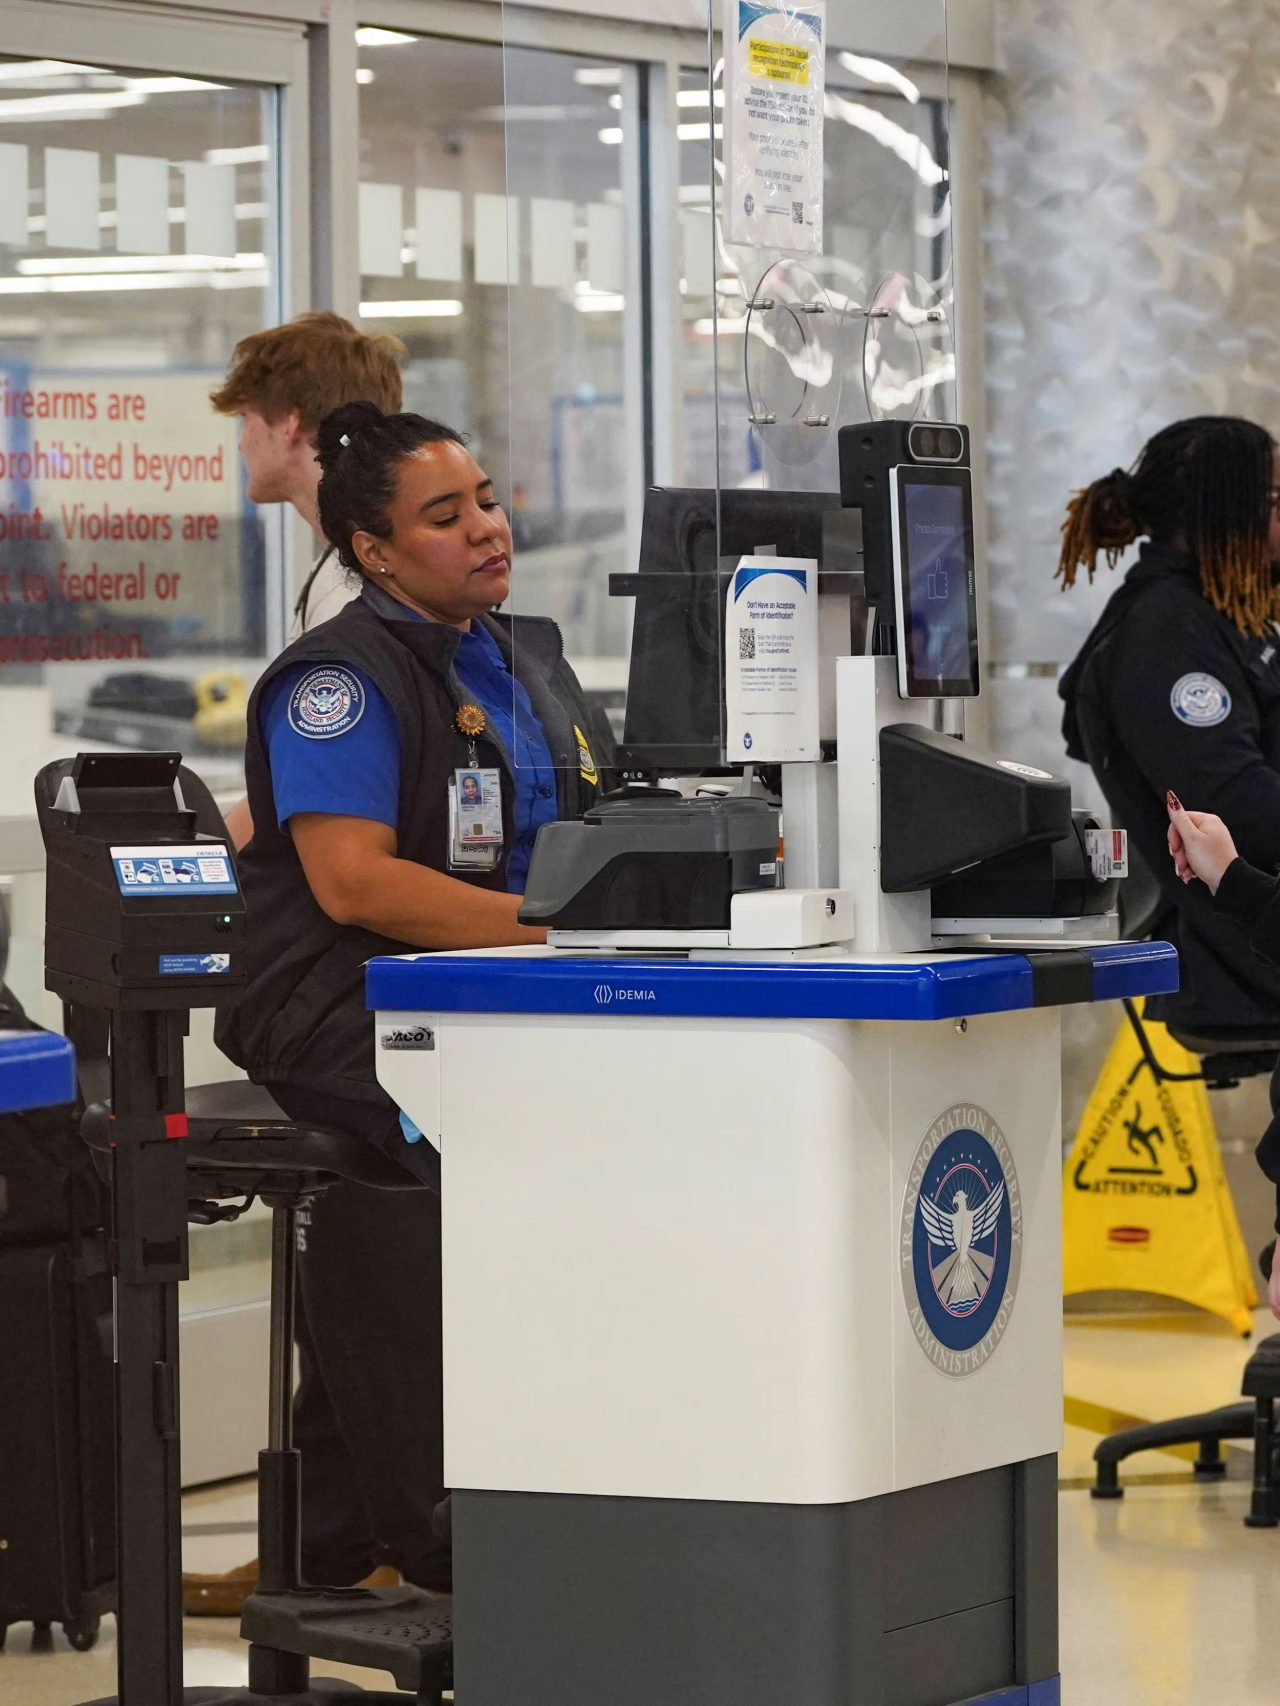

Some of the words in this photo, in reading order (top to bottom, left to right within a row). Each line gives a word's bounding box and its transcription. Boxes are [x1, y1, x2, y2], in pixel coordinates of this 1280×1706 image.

[108, 392, 146, 421] are
[133, 442, 224, 491] beyond
[61, 503, 173, 542] Violators
[182, 513, 220, 541] are
[22, 567, 49, 603] to
[58, 561, 146, 602] federal
[155, 571, 182, 601] or
[293, 670, 340, 709] TRANSPORTATION
[340, 673, 359, 702] SECURITY
[297, 716, 351, 732] ADMINISTRATION
[615, 990, 656, 1000] IDEMIA
[1083, 1084, 1130, 1160] CAUTION
[902, 1107, 987, 1269] TRANSPORTATION
[988, 1125, 1022, 1242] SECURITY
[1091, 1179, 1174, 1197] ATTENTION
[908, 1289, 1015, 1373] ADMINISTRATION
